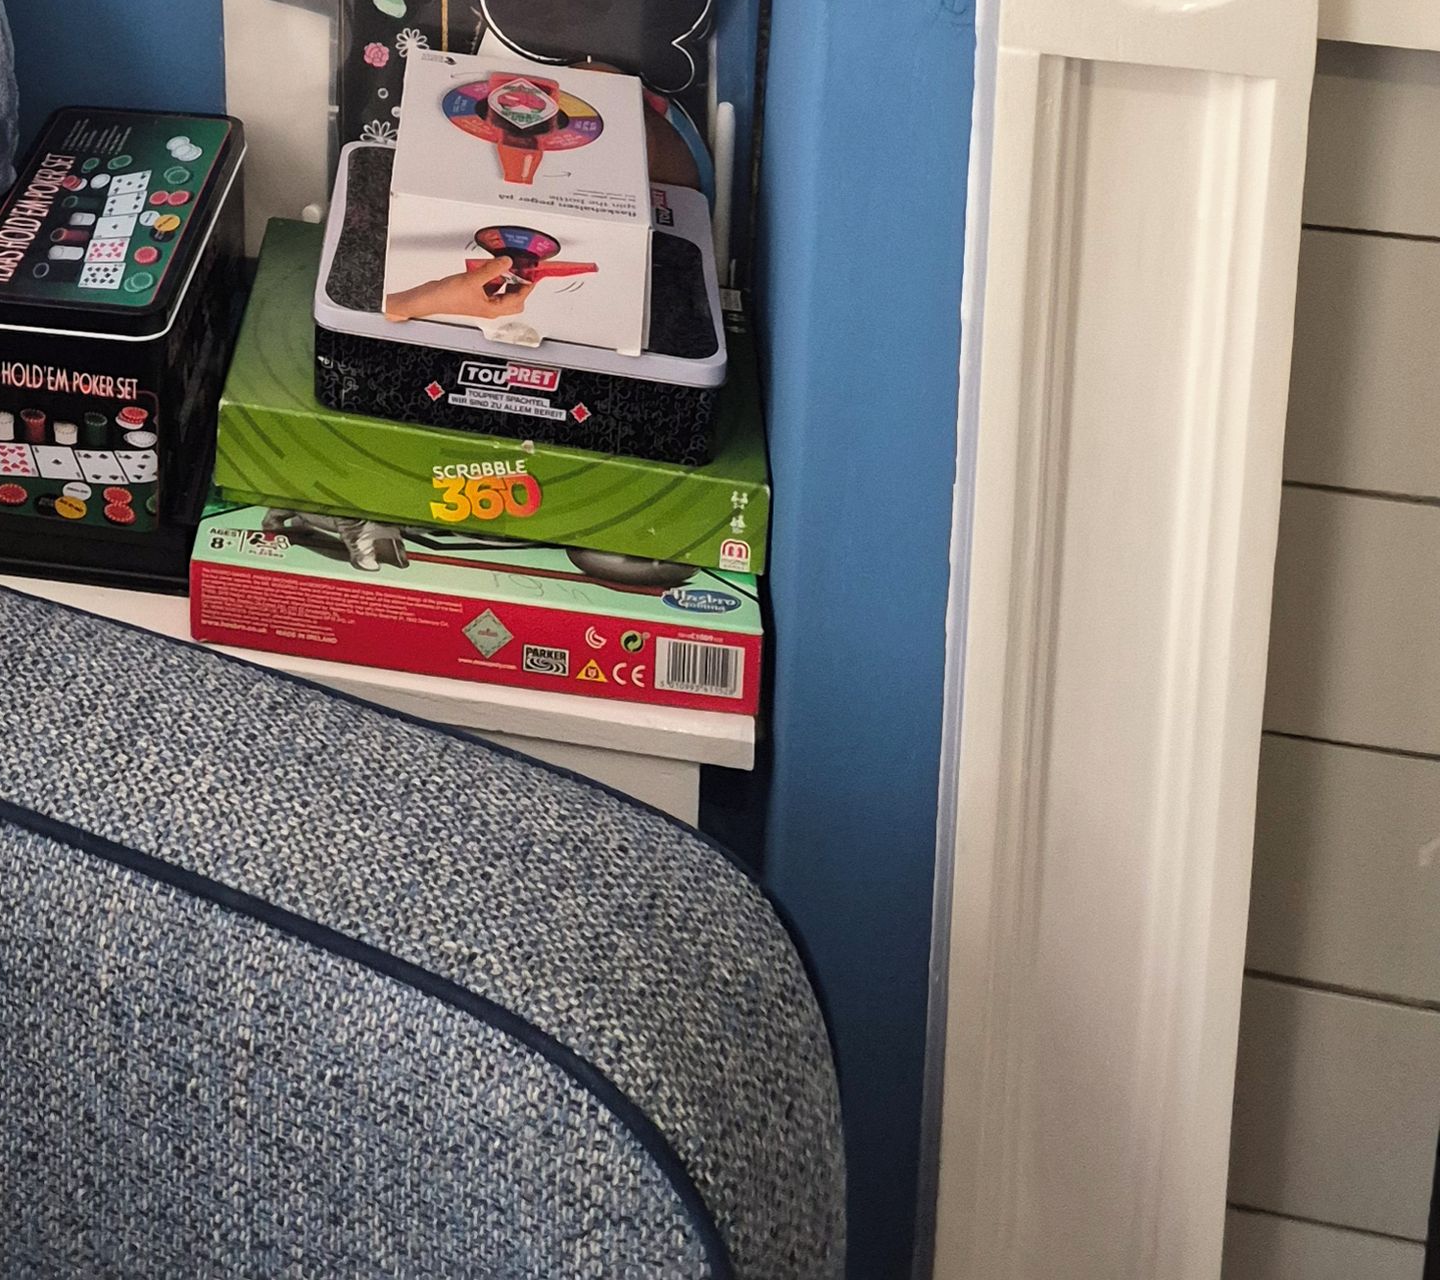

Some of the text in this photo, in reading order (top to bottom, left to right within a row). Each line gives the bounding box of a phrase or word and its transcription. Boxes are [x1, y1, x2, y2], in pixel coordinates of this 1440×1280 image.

[41, 153, 76, 169] SET
[24, 169, 68, 199] POKER
[1, 361, 70, 393] HOLD'EM
[73, 371, 114, 399] POKER
[117, 377, 138, 400] SET
[466, 366, 554, 386] TOUPRET
[468, 390, 504, 403] TOUPRET
[451, 396, 564, 420] WIR SIND ZU ALLEM BEREIT
[432, 460, 528, 480] SCRABBLE
[430, 474, 542, 522] 360
[210, 528, 237, 538] AGES
[661, 588, 737, 607] Hasbro
[526, 647, 567, 661] PARKER
